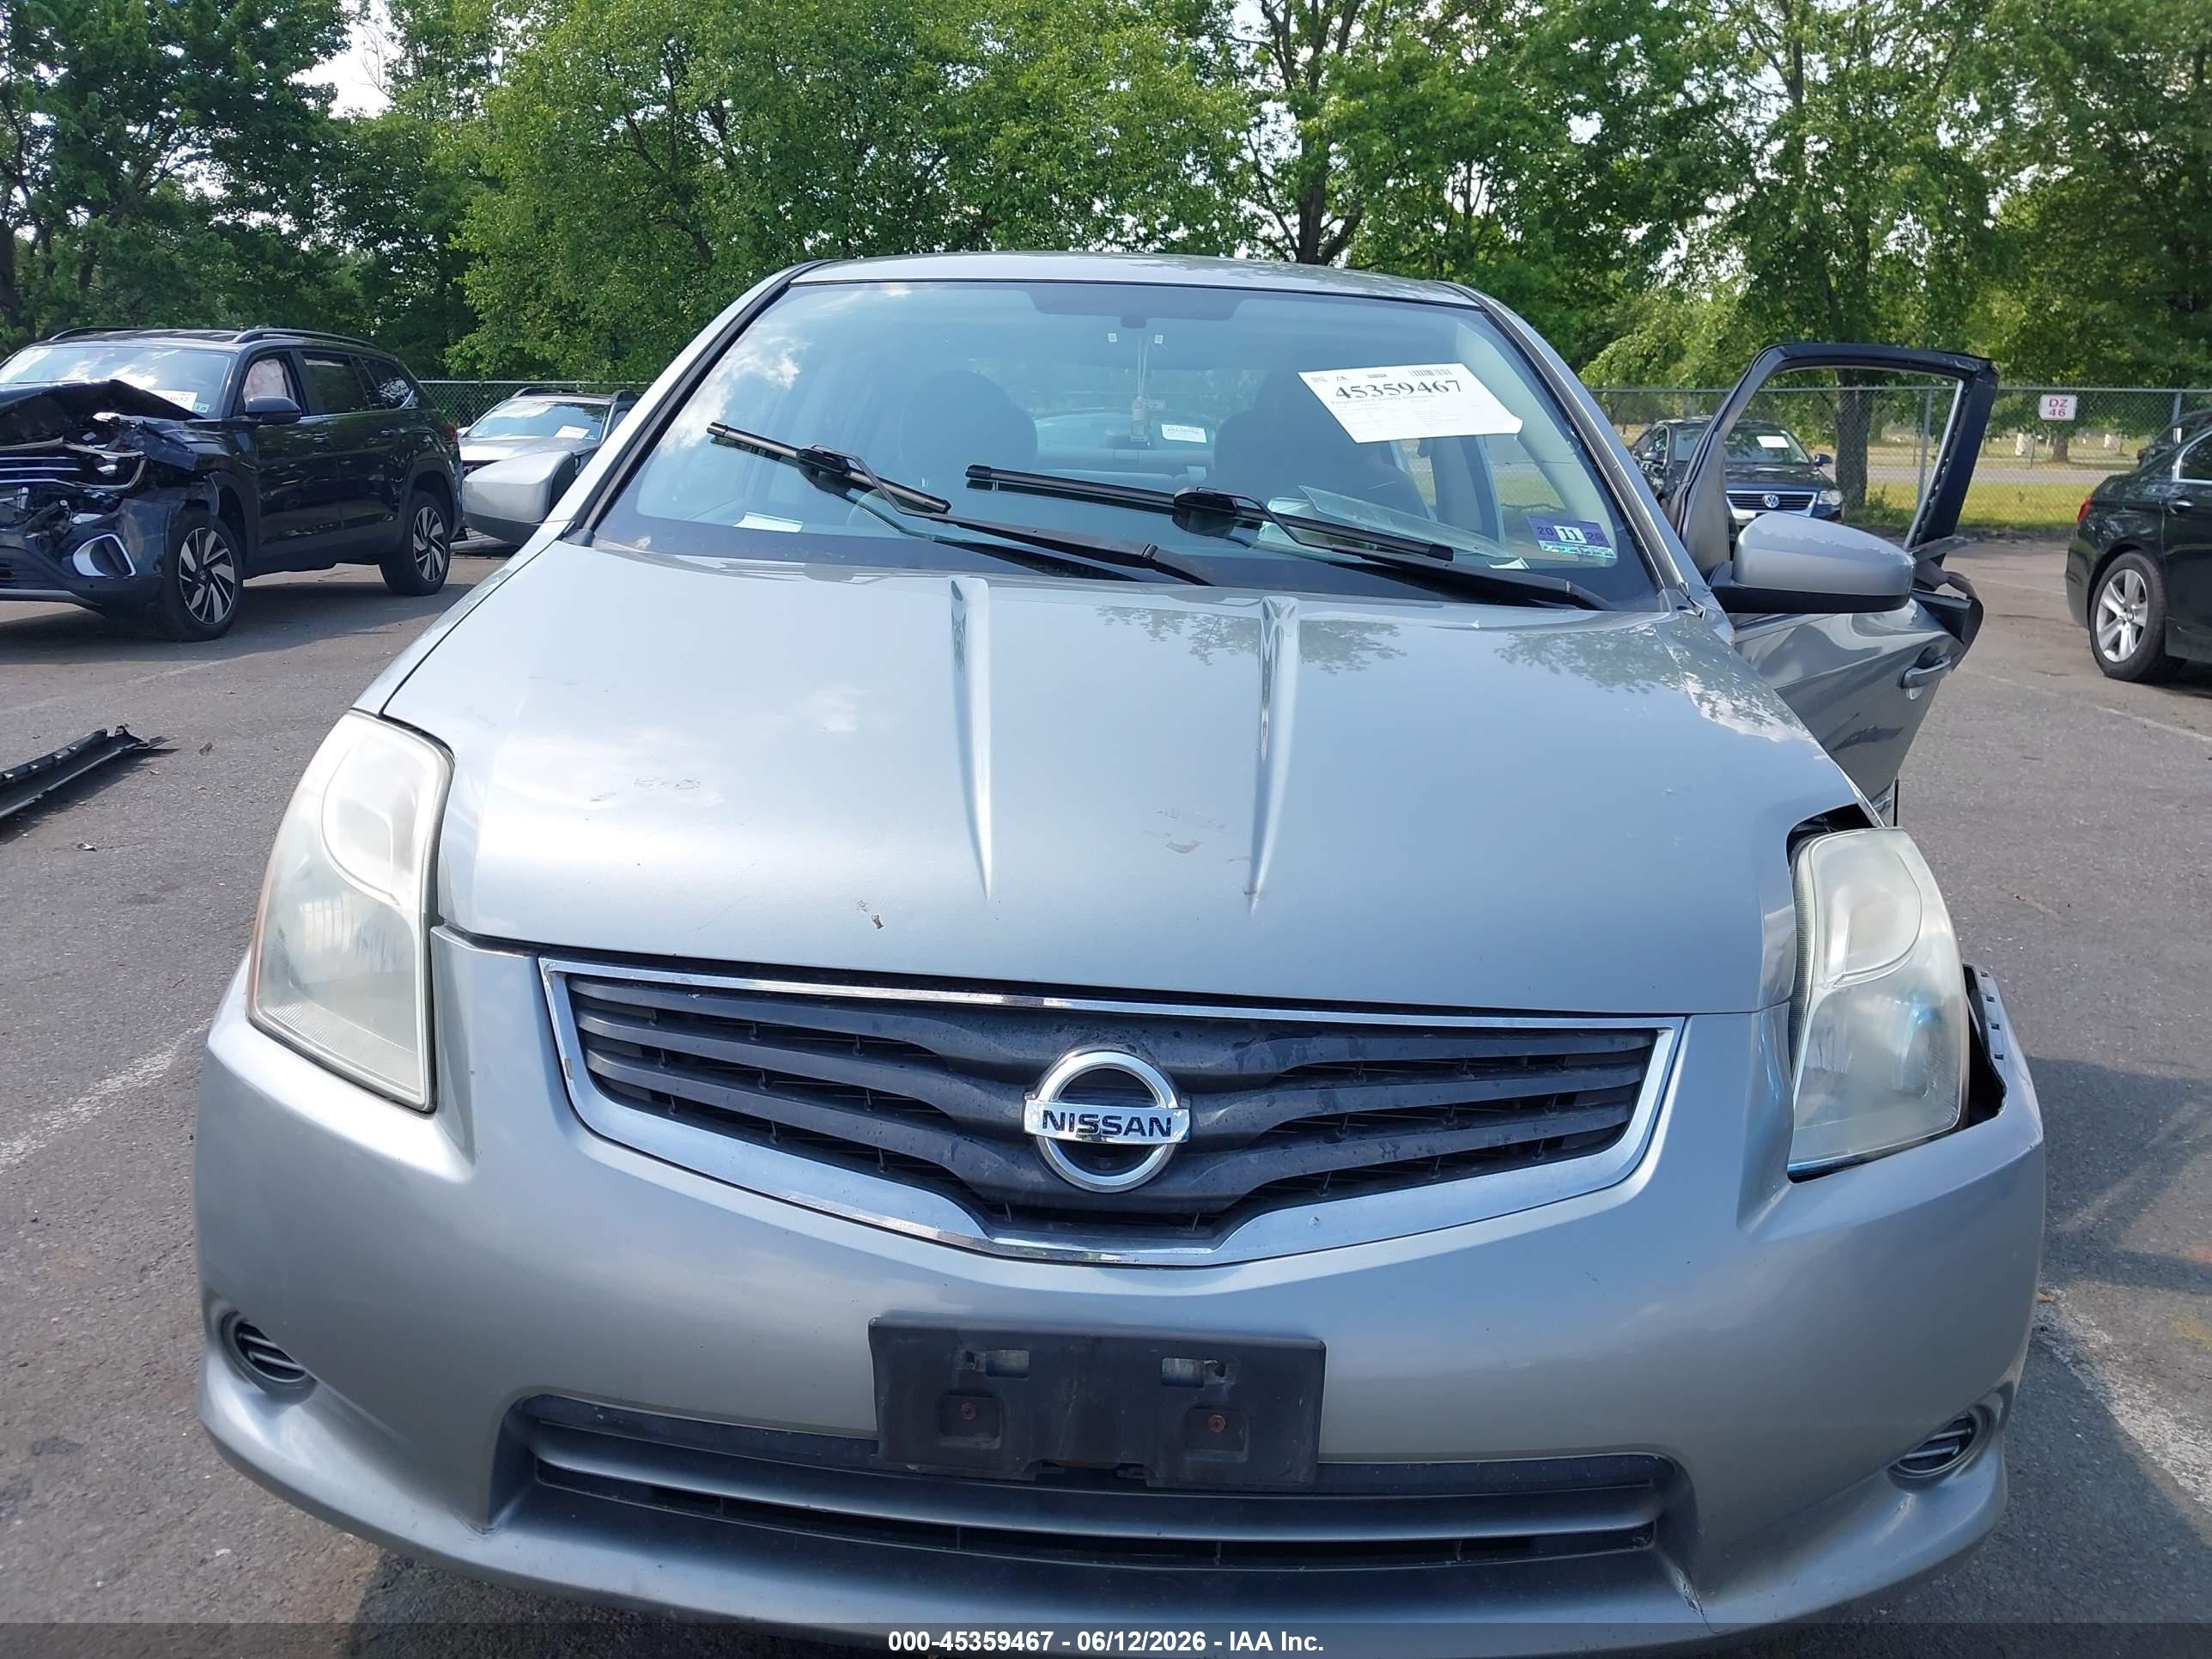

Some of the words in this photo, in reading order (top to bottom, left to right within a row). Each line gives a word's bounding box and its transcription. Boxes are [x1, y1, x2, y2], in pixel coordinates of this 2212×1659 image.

[1335, 379, 1462, 399] 45359467
[2049, 398, 2069, 408] DZ
[2048, 408, 2066, 417] 46
[1559, 527, 1582, 542] 11
[1042, 1109, 1172, 1138] NISSAN
